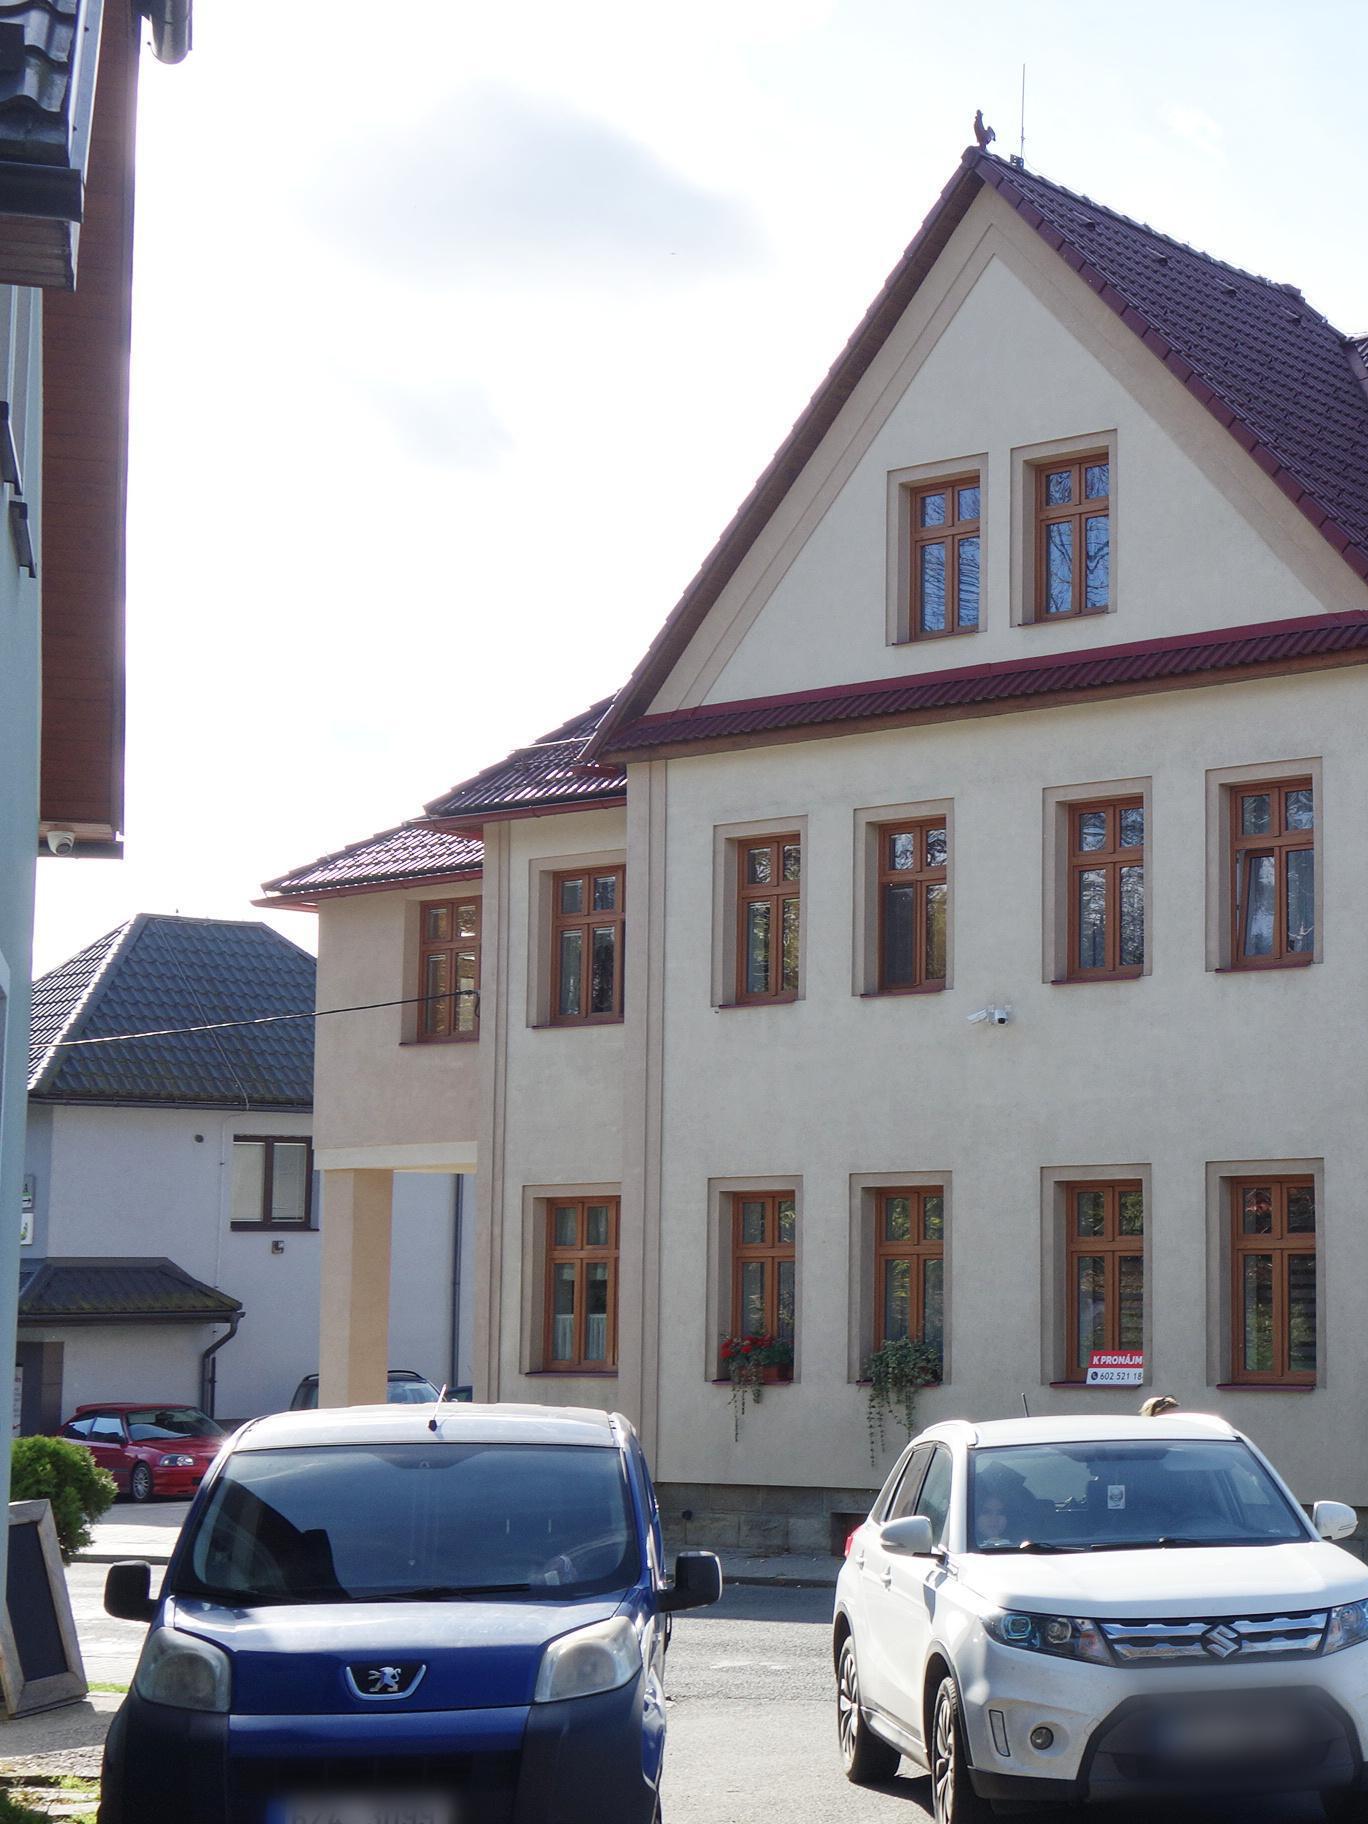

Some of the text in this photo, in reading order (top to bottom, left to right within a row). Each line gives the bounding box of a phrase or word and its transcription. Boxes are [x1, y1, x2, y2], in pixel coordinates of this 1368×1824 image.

[1092, 1355, 1100, 1365] K
[1100, 1372, 1114, 1381] 602
[1116, 1372, 1130, 1381] 521
